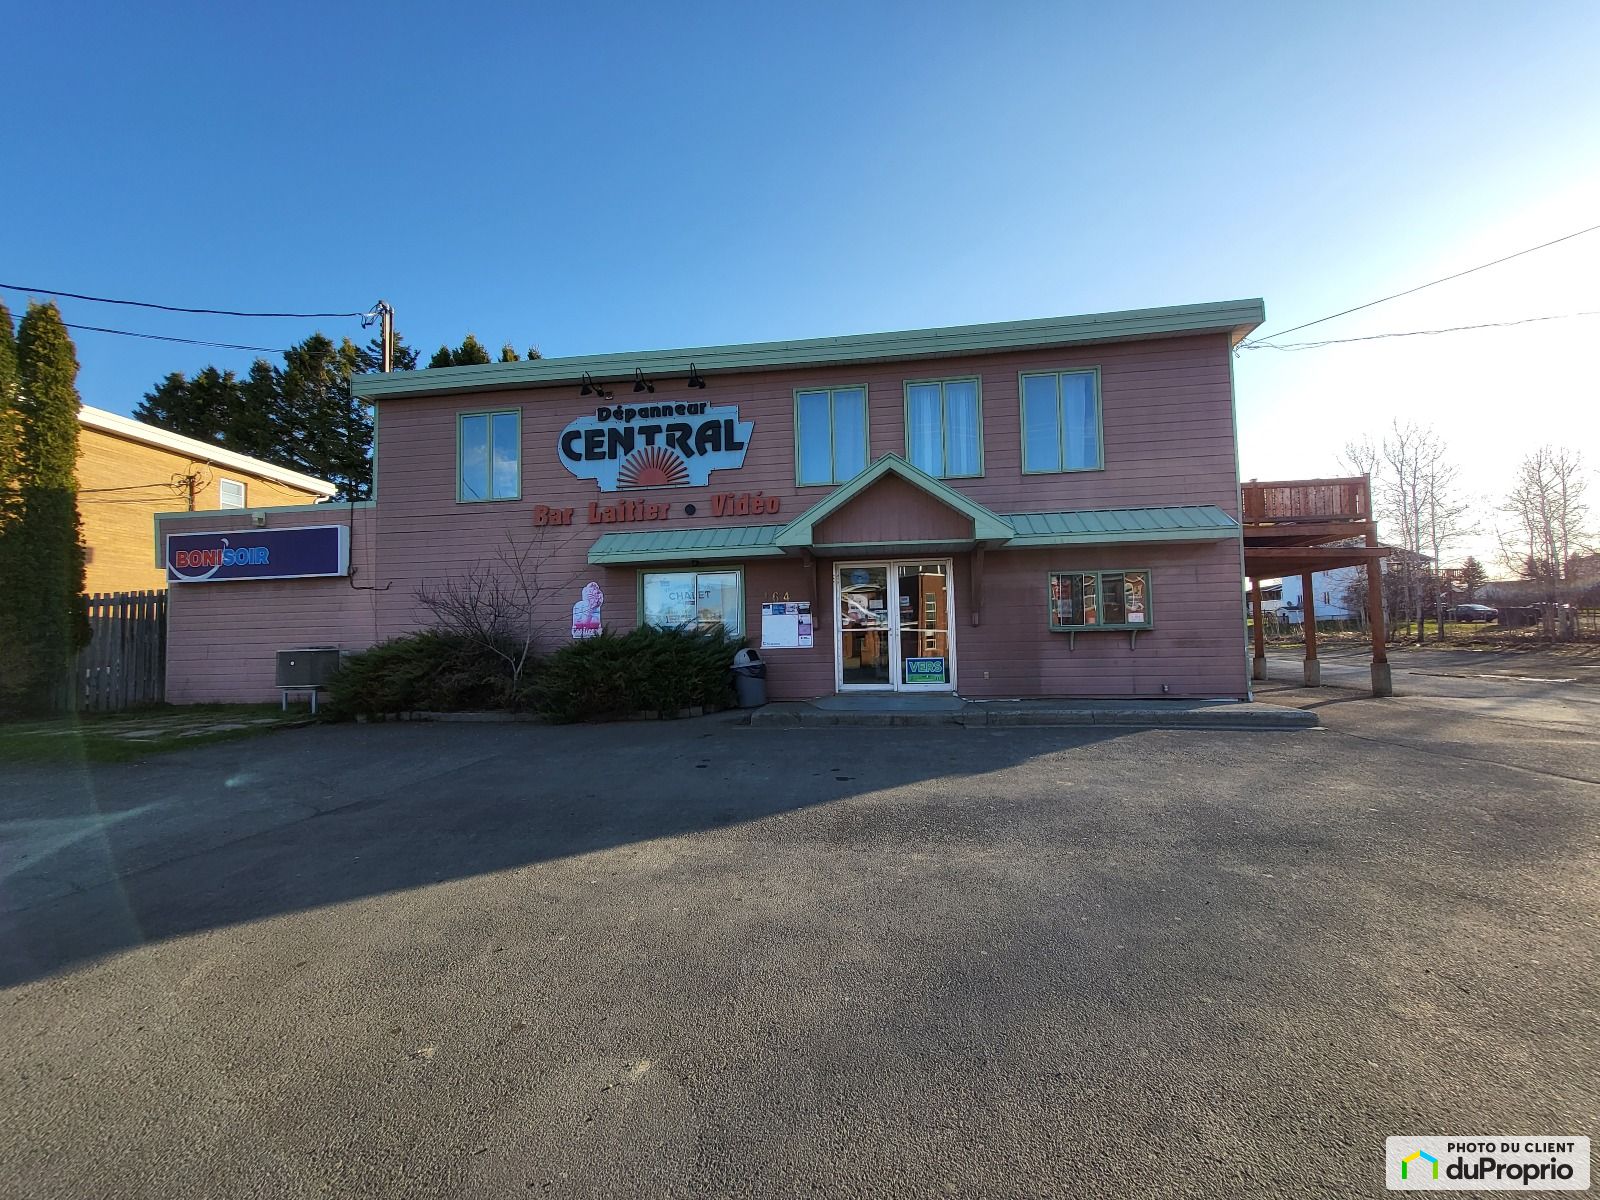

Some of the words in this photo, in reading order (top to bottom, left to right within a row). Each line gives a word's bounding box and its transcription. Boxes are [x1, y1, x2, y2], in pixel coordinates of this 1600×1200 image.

[597, 401, 707, 422] Dépanneur
[561, 419, 745, 461] CENTRAL
[533, 503, 574, 527] Bar
[588, 500, 670, 525] Laitier
[711, 491, 780, 517] Vidéo
